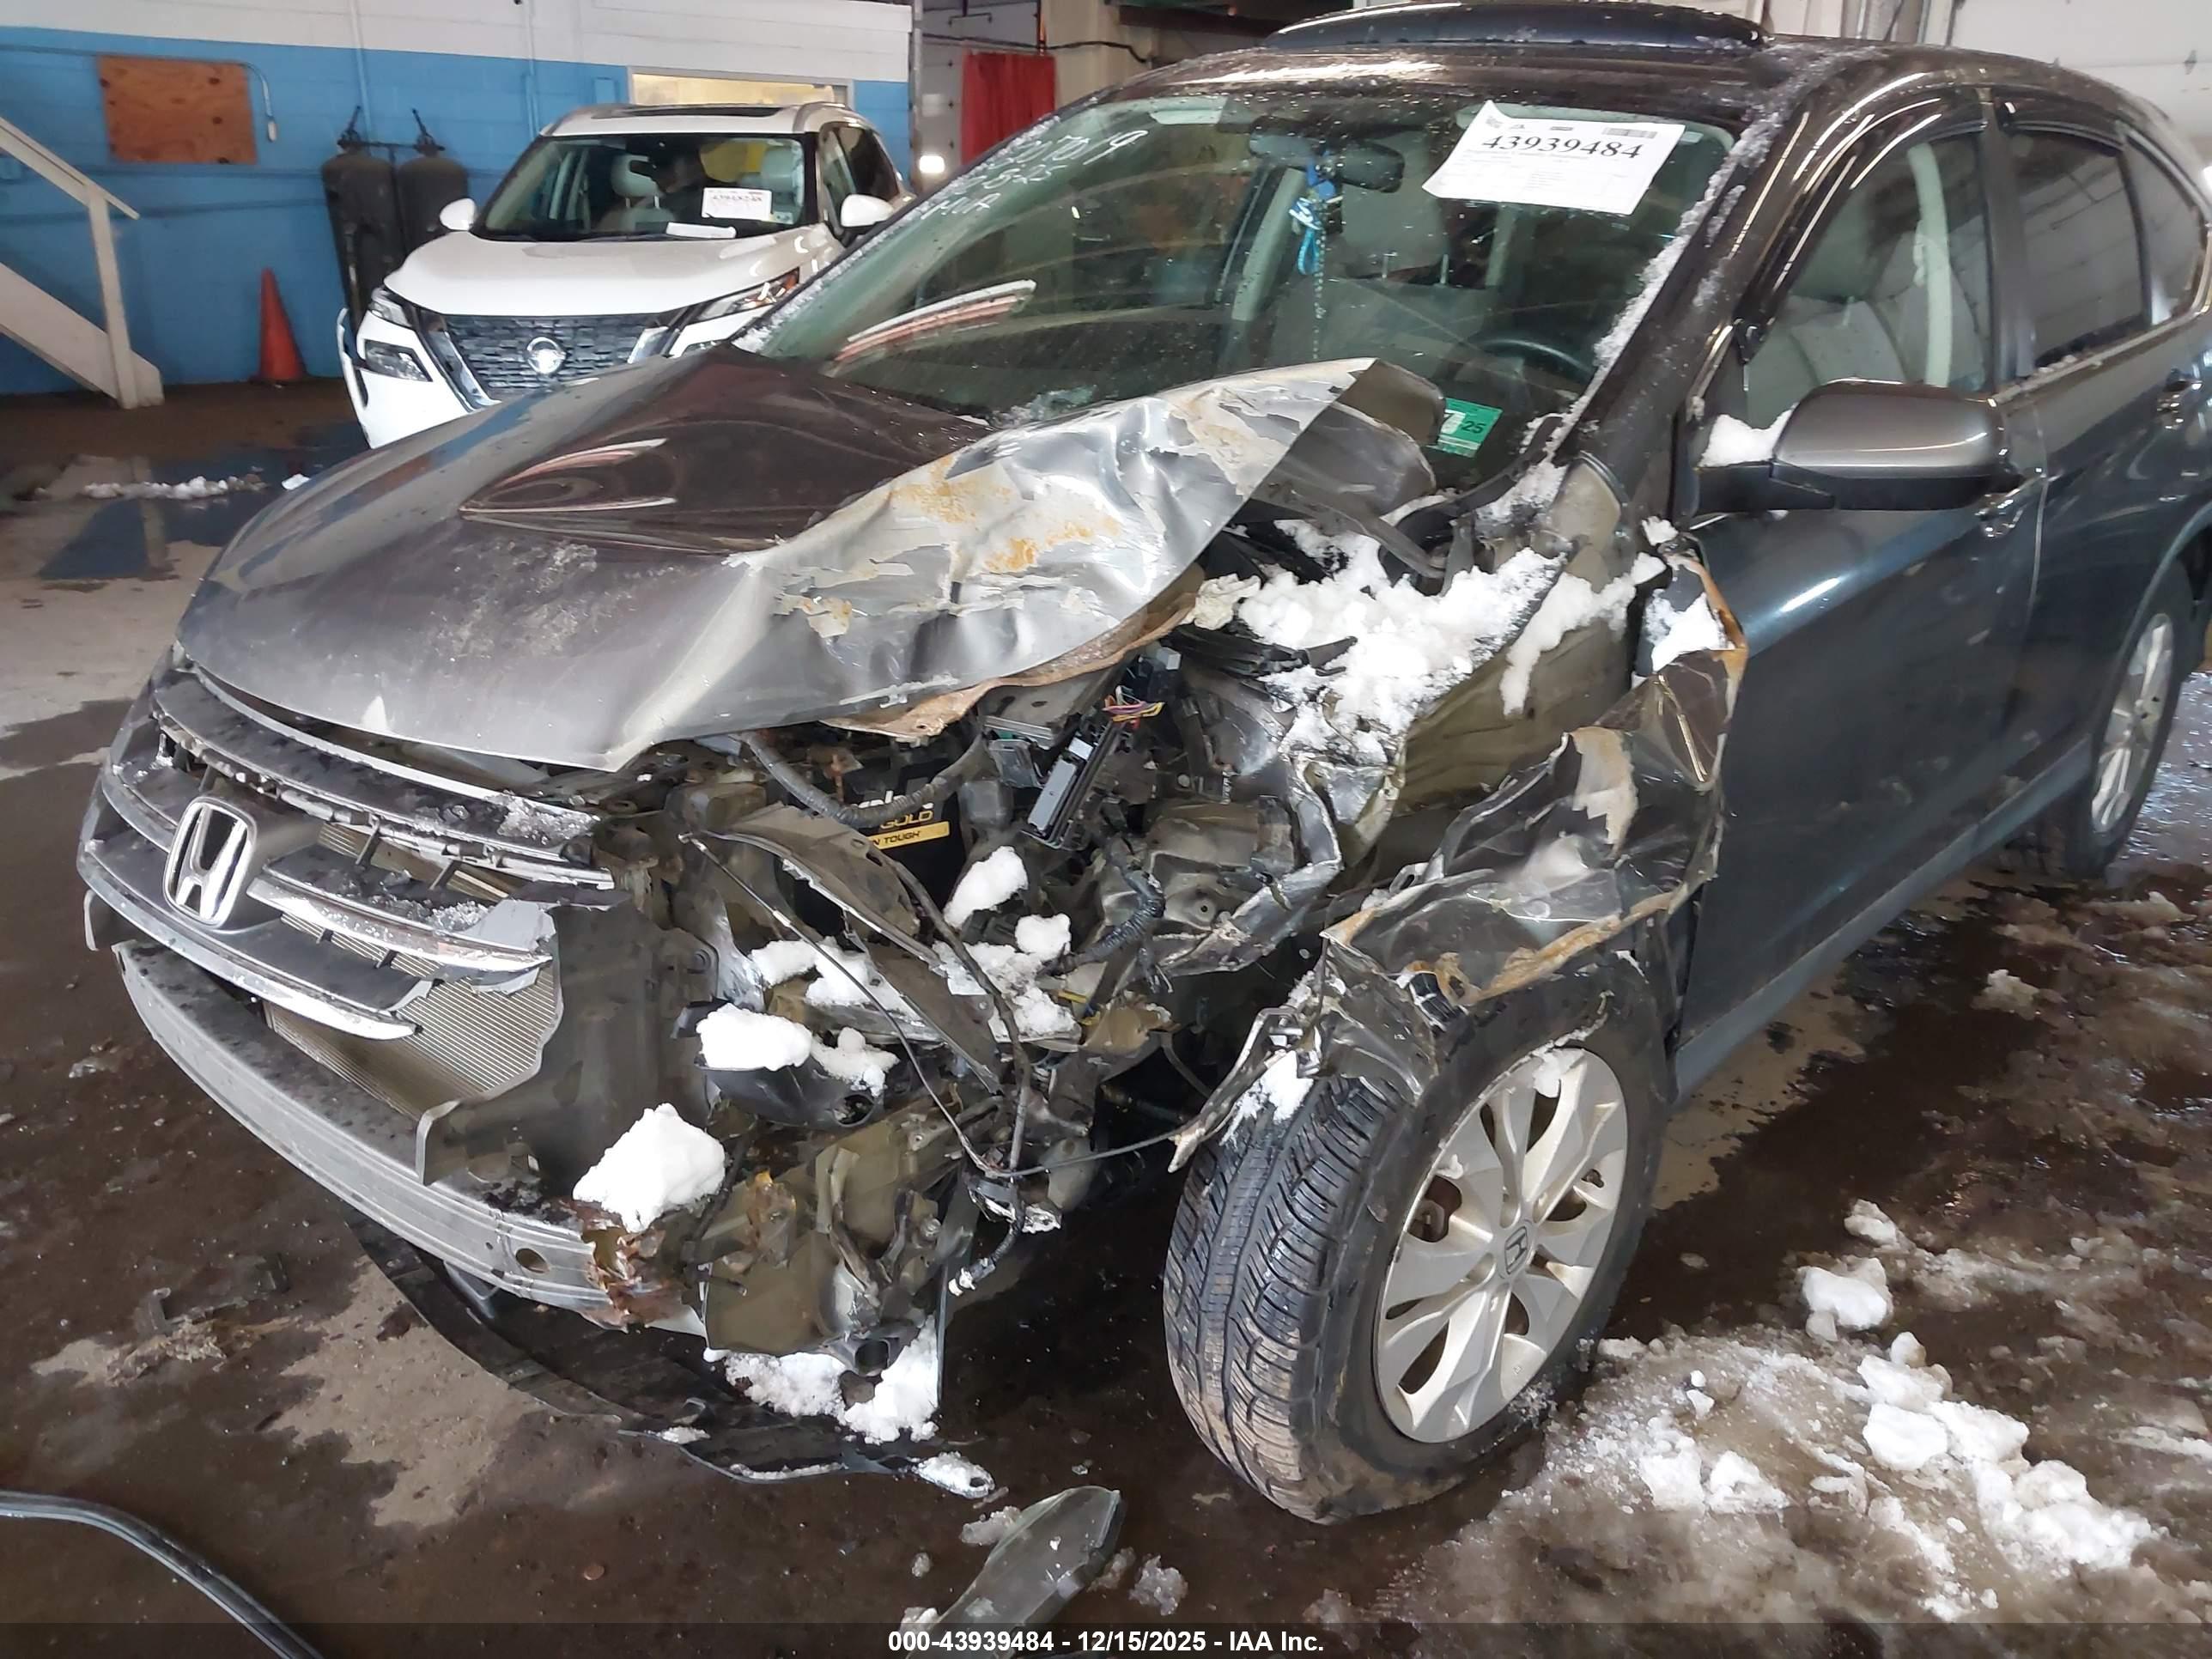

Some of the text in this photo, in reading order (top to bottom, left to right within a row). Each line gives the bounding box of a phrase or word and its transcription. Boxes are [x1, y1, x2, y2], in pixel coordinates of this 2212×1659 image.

[1482, 136, 1644, 159] 43939484
[1462, 421, 1486, 434] 25
[884, 830, 921, 844] TOUGH
